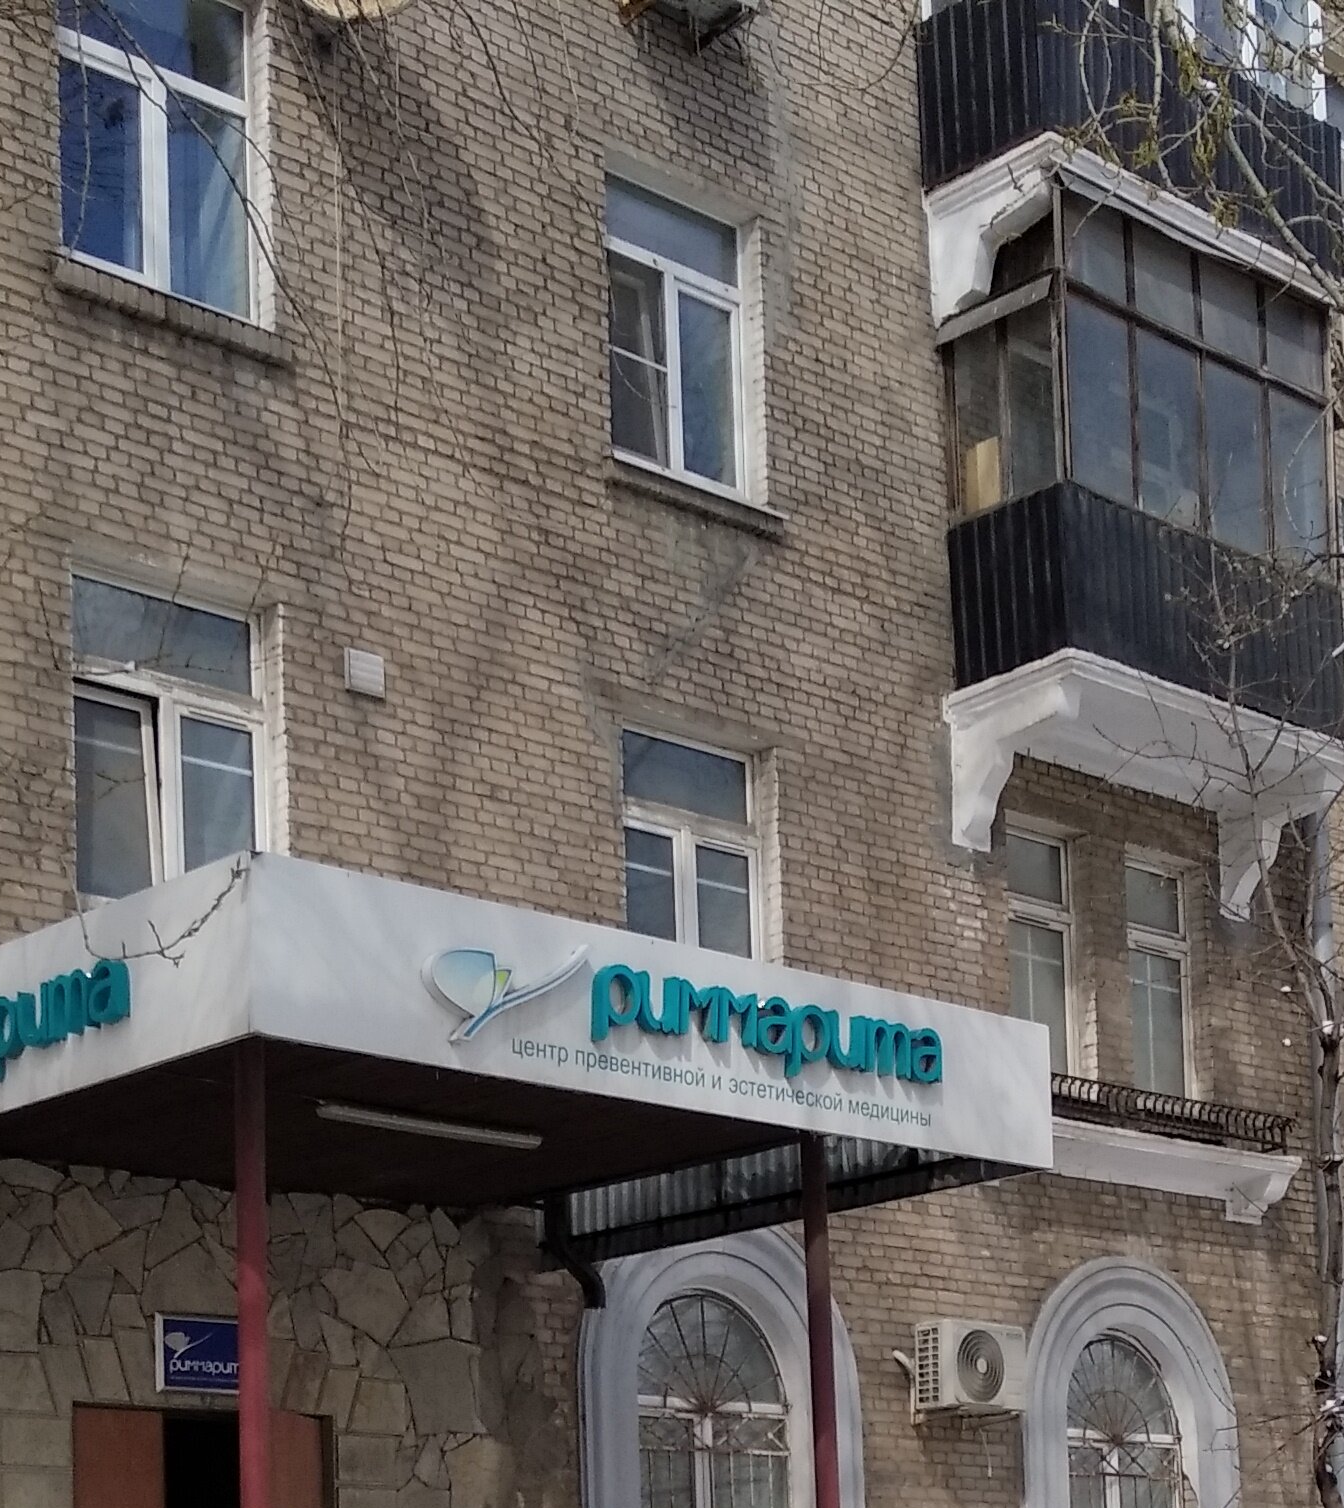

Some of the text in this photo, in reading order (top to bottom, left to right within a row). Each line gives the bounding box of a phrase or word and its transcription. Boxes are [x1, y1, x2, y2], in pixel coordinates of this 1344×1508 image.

[590, 963, 943, 1085] риммарита
[511, 1037, 932, 1128] центр превентивной и эстетической медицины
[169, 1358, 240, 1376] риммарит
